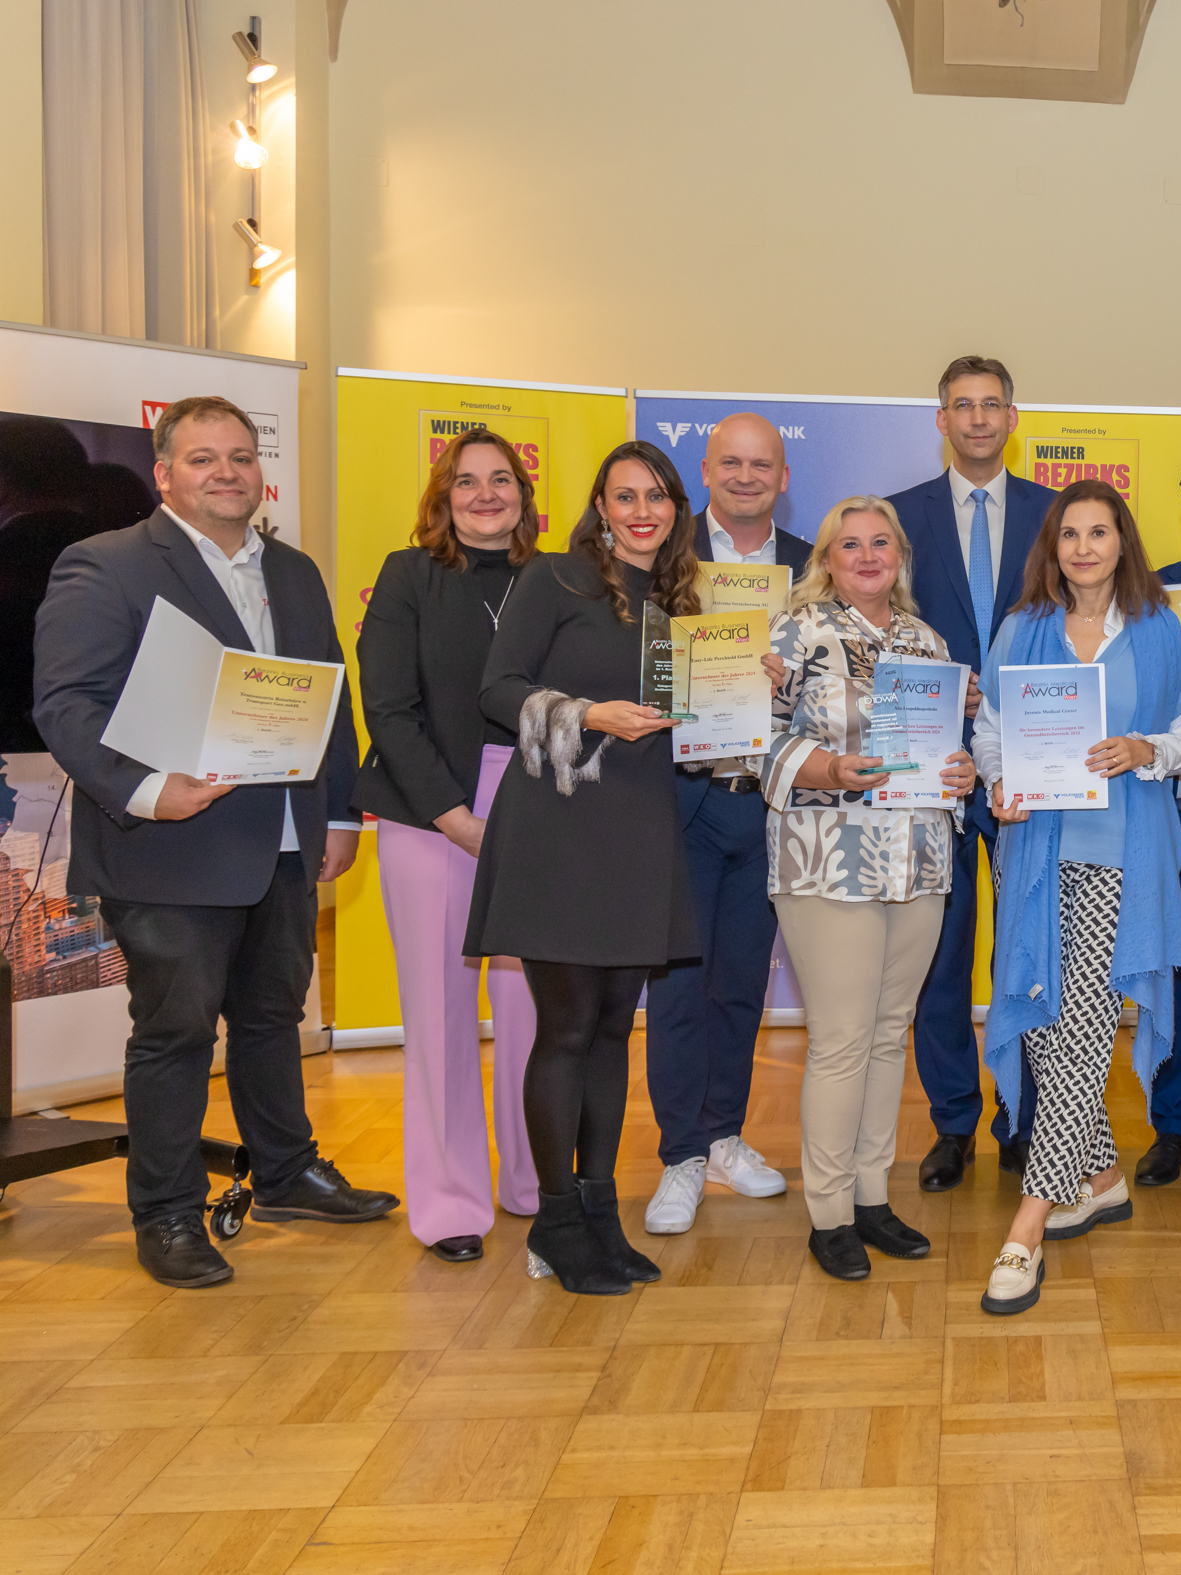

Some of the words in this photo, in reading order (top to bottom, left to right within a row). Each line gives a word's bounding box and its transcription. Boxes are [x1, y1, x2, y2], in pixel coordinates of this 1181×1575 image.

[461, 401, 500, 410] Presented
[502, 404, 512, 412] by
[1062, 427, 1096, 435] Presented
[1098, 428, 1106, 436] by
[1036, 445, 1085, 460] WIENER
[1034, 462, 1130, 489] BEZIRKS
[713, 573, 769, 588] Award
[693, 623, 749, 642] Award
[244, 668, 312, 688] Award
[893, 678, 940, 695] Award
[1023, 682, 1077, 698] Award
